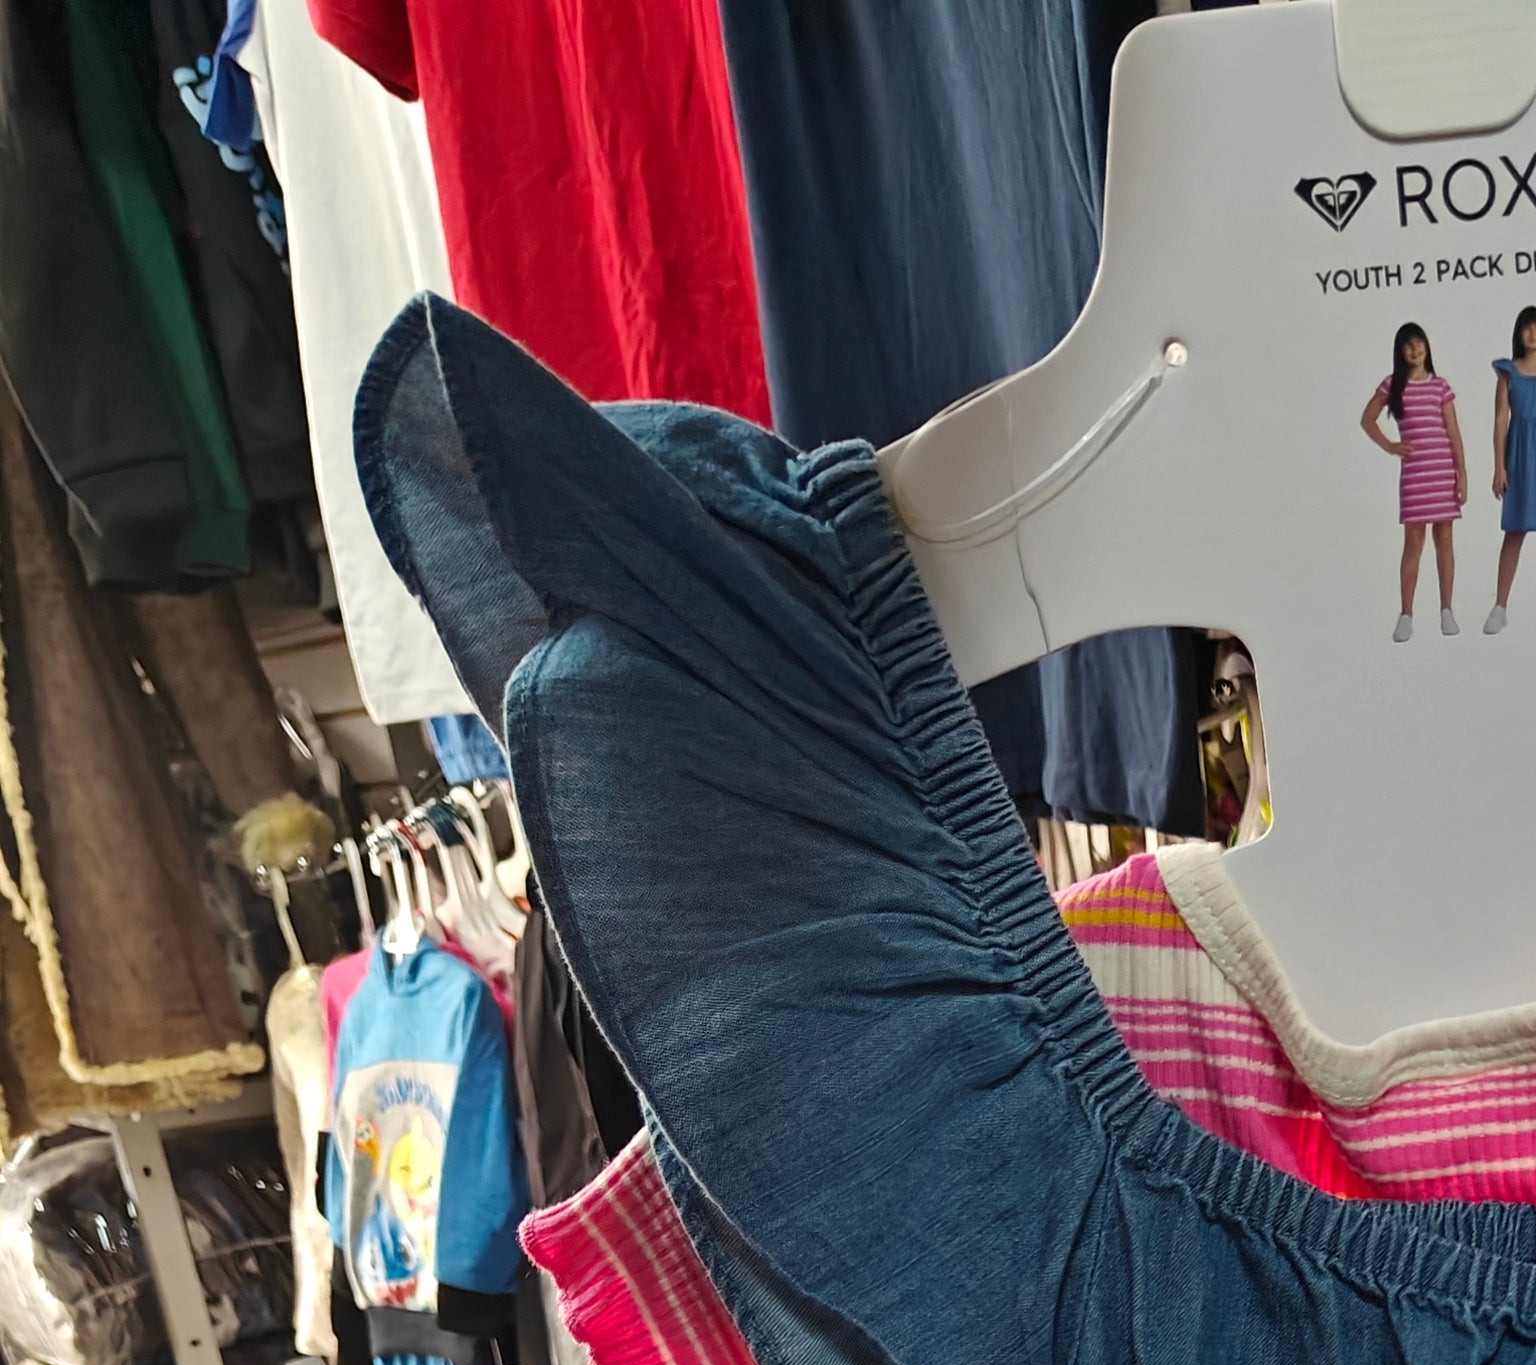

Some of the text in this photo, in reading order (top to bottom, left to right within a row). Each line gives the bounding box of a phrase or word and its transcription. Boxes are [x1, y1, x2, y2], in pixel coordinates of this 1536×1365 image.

[1316, 263, 1402, 295] YOUTH
[1412, 261, 1427, 286] 2
[1436, 252, 1504, 283] PACK
